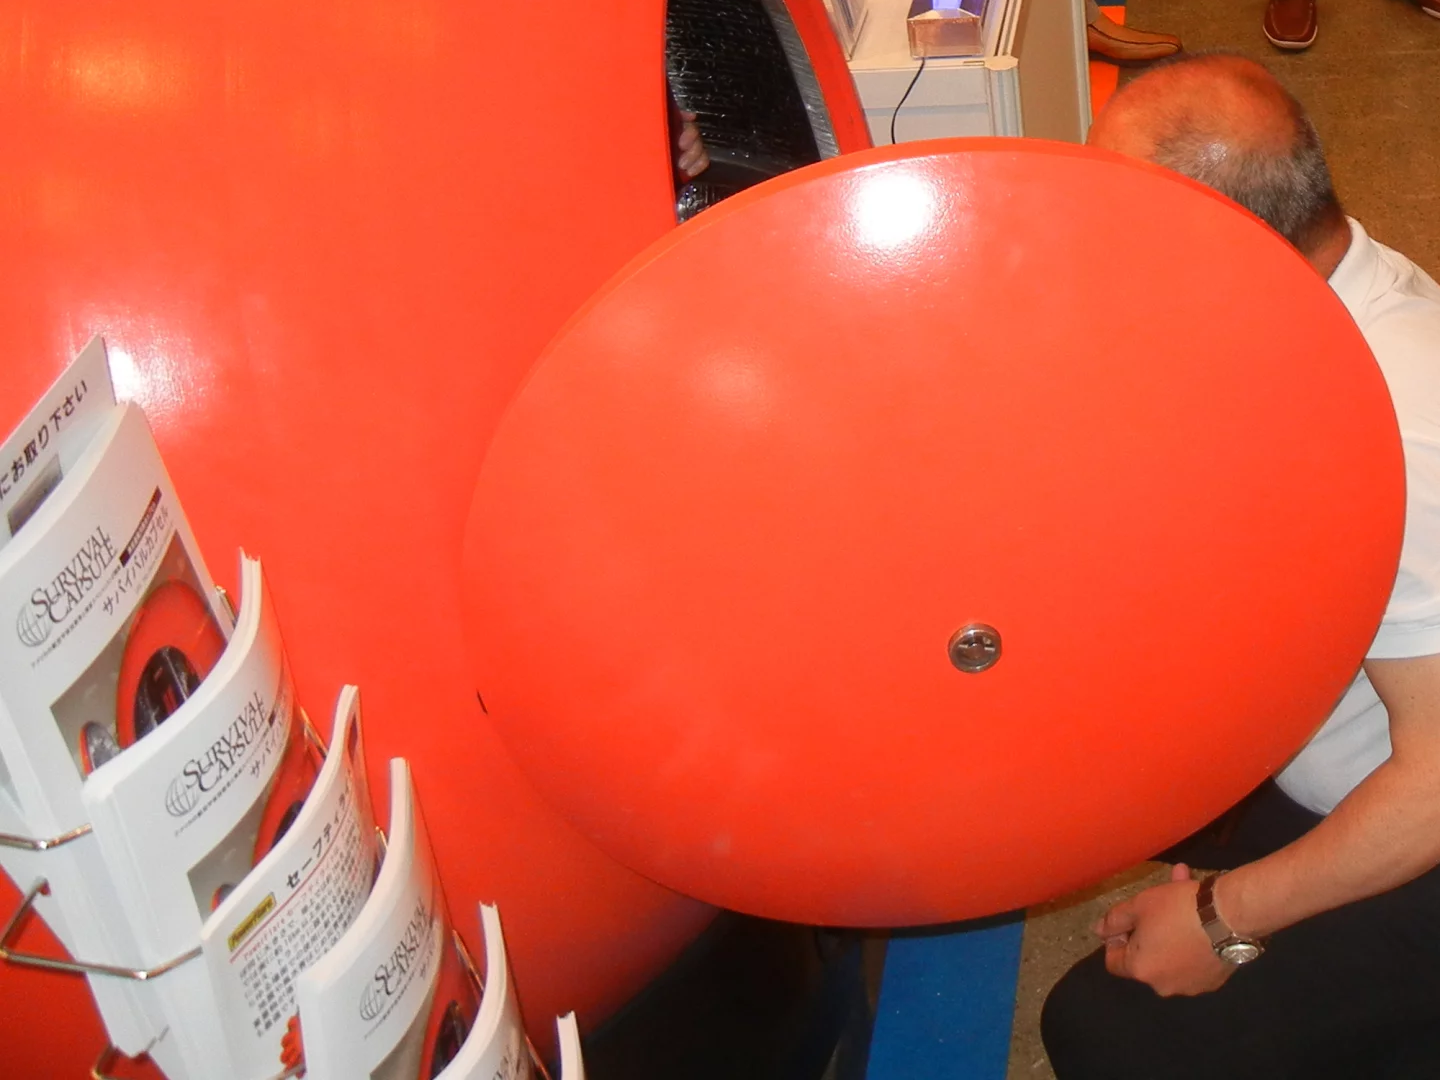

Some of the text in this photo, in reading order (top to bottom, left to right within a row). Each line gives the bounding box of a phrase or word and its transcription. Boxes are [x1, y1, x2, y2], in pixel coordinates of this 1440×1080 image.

[31, 524, 113, 617] SURVIVAL
[48, 542, 119, 625] CAPSULE
[102, 506, 170, 618] サバイバルカプセル
[181, 692, 266, 791] SURVIVAL
